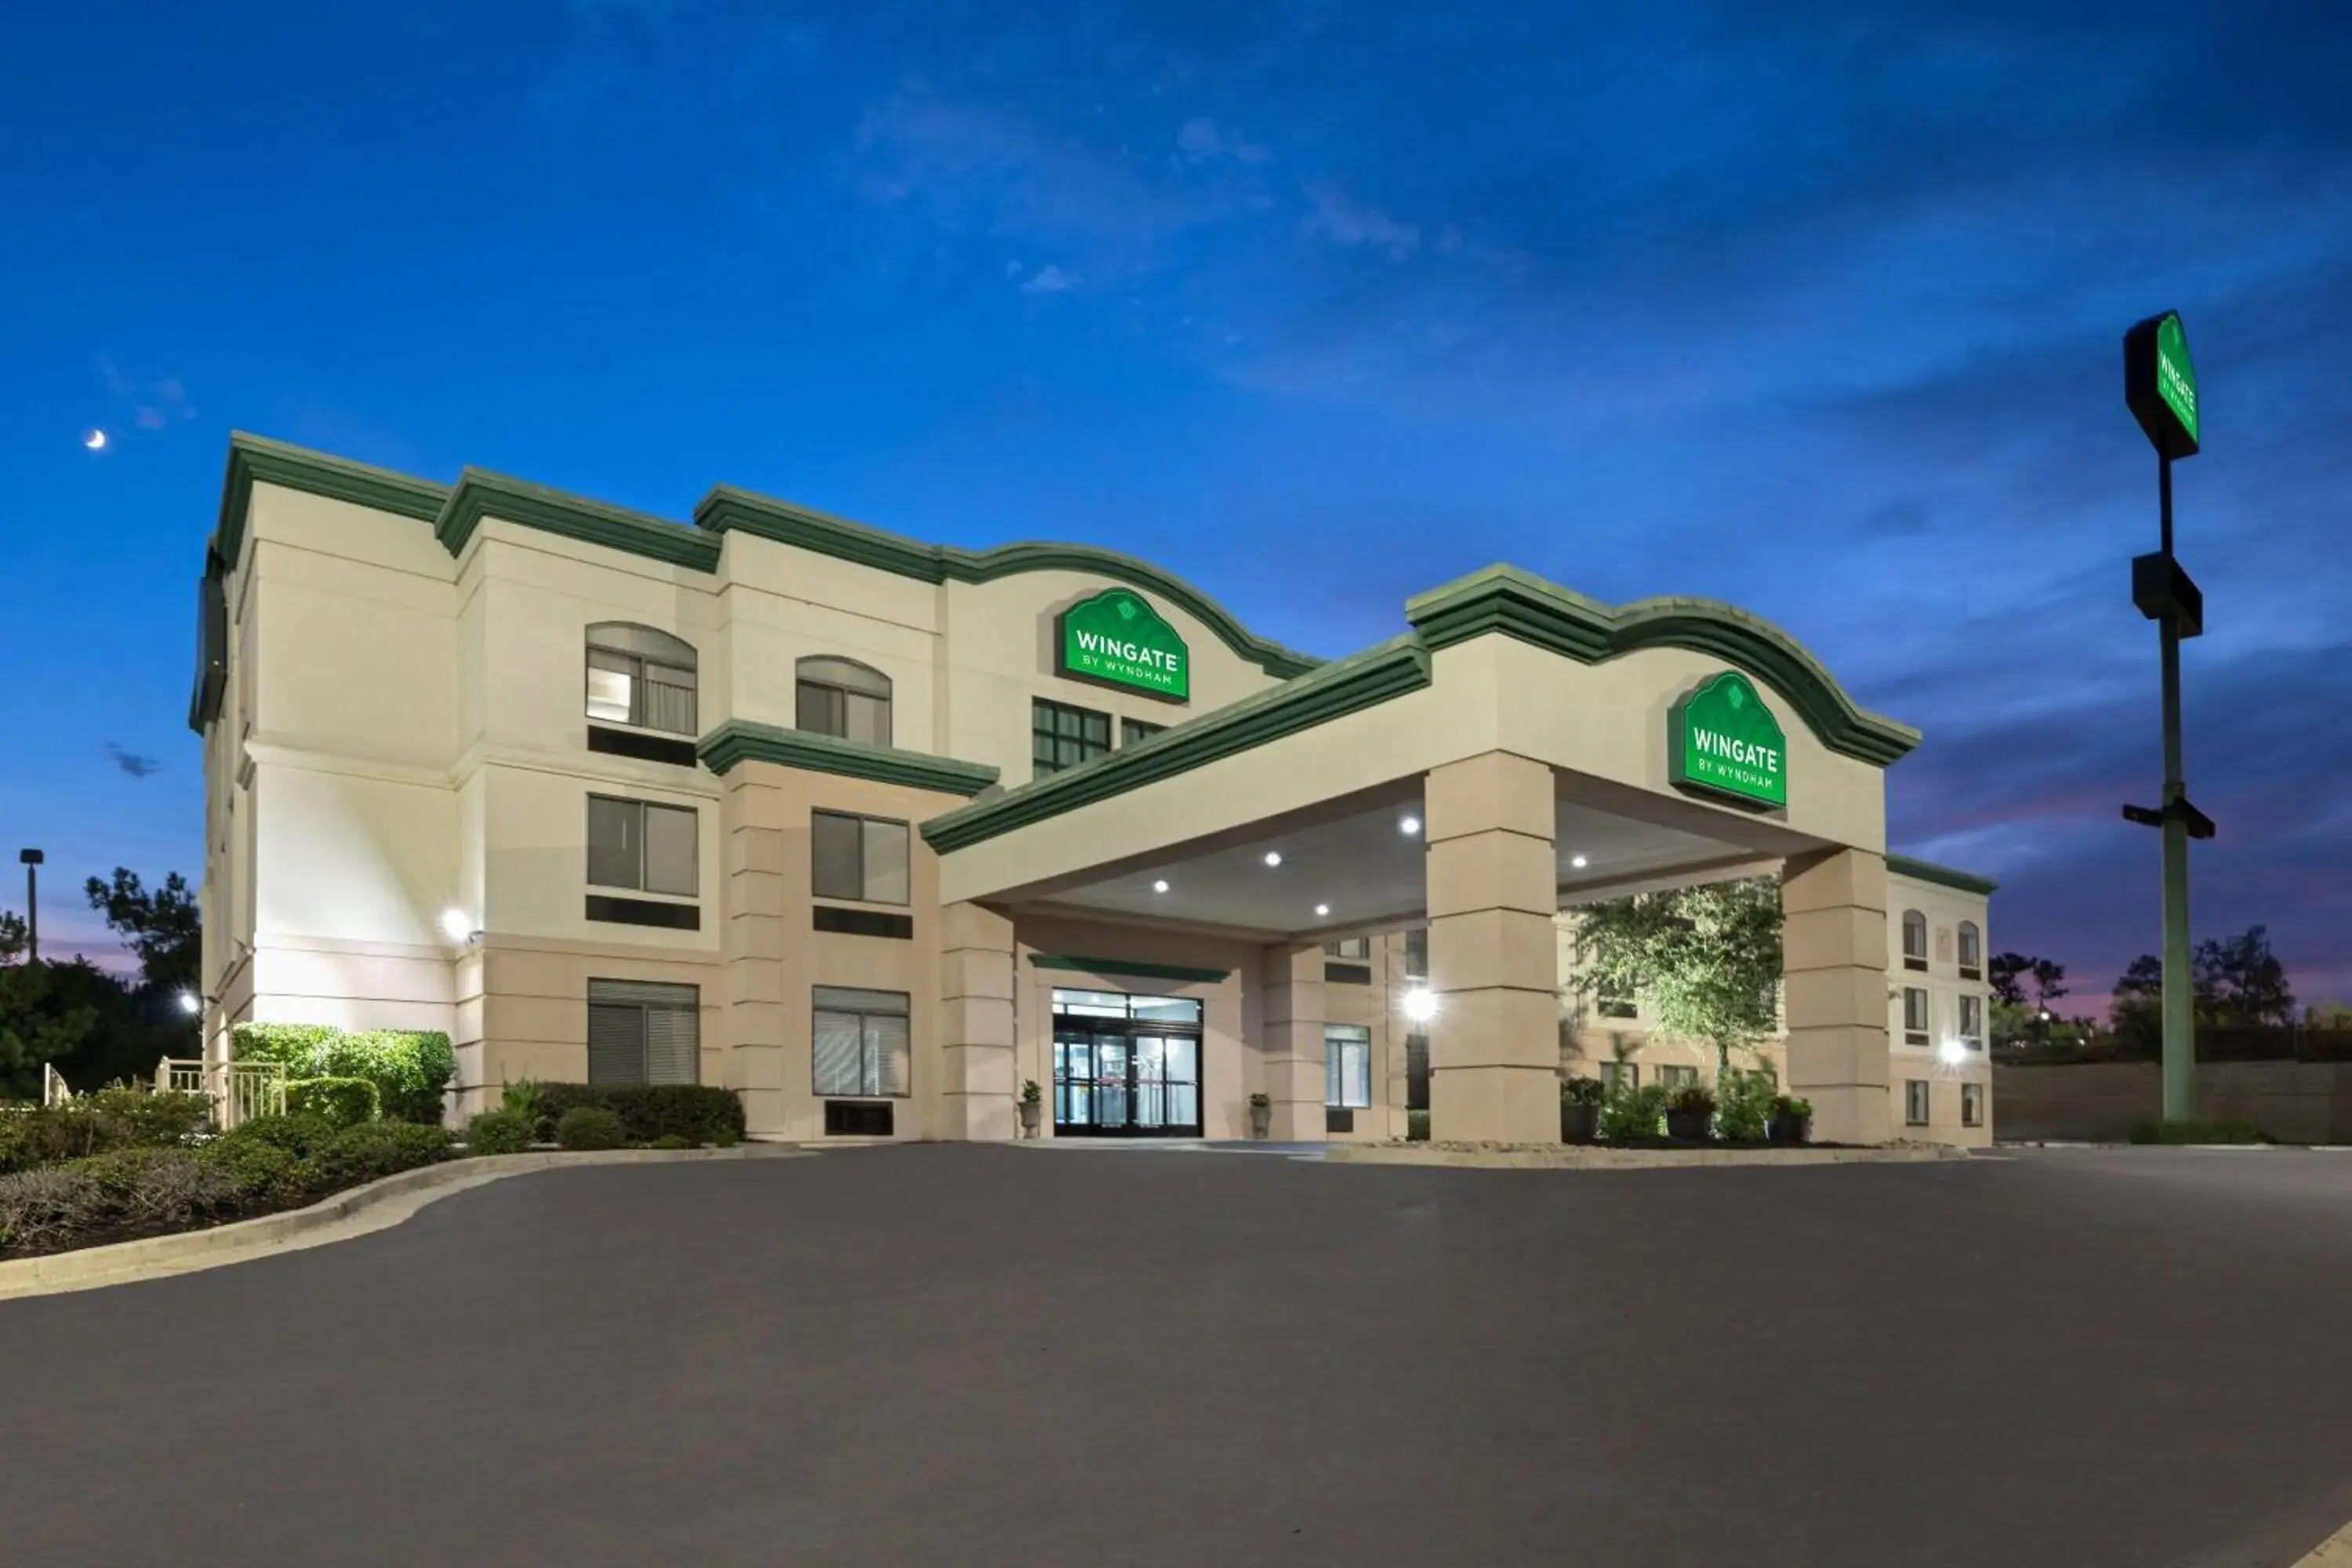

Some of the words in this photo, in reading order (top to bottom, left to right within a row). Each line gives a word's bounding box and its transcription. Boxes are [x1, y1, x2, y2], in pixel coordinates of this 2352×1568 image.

[1076, 630, 1178, 672] WINGATE
[1083, 655, 1098, 666] BY
[1105, 660, 1173, 684] WYNDHAM
[1693, 728, 1778, 772] WINGATE
[1699, 758, 1712, 771] BY
[1717, 764, 1773, 789] WYNDHAM
